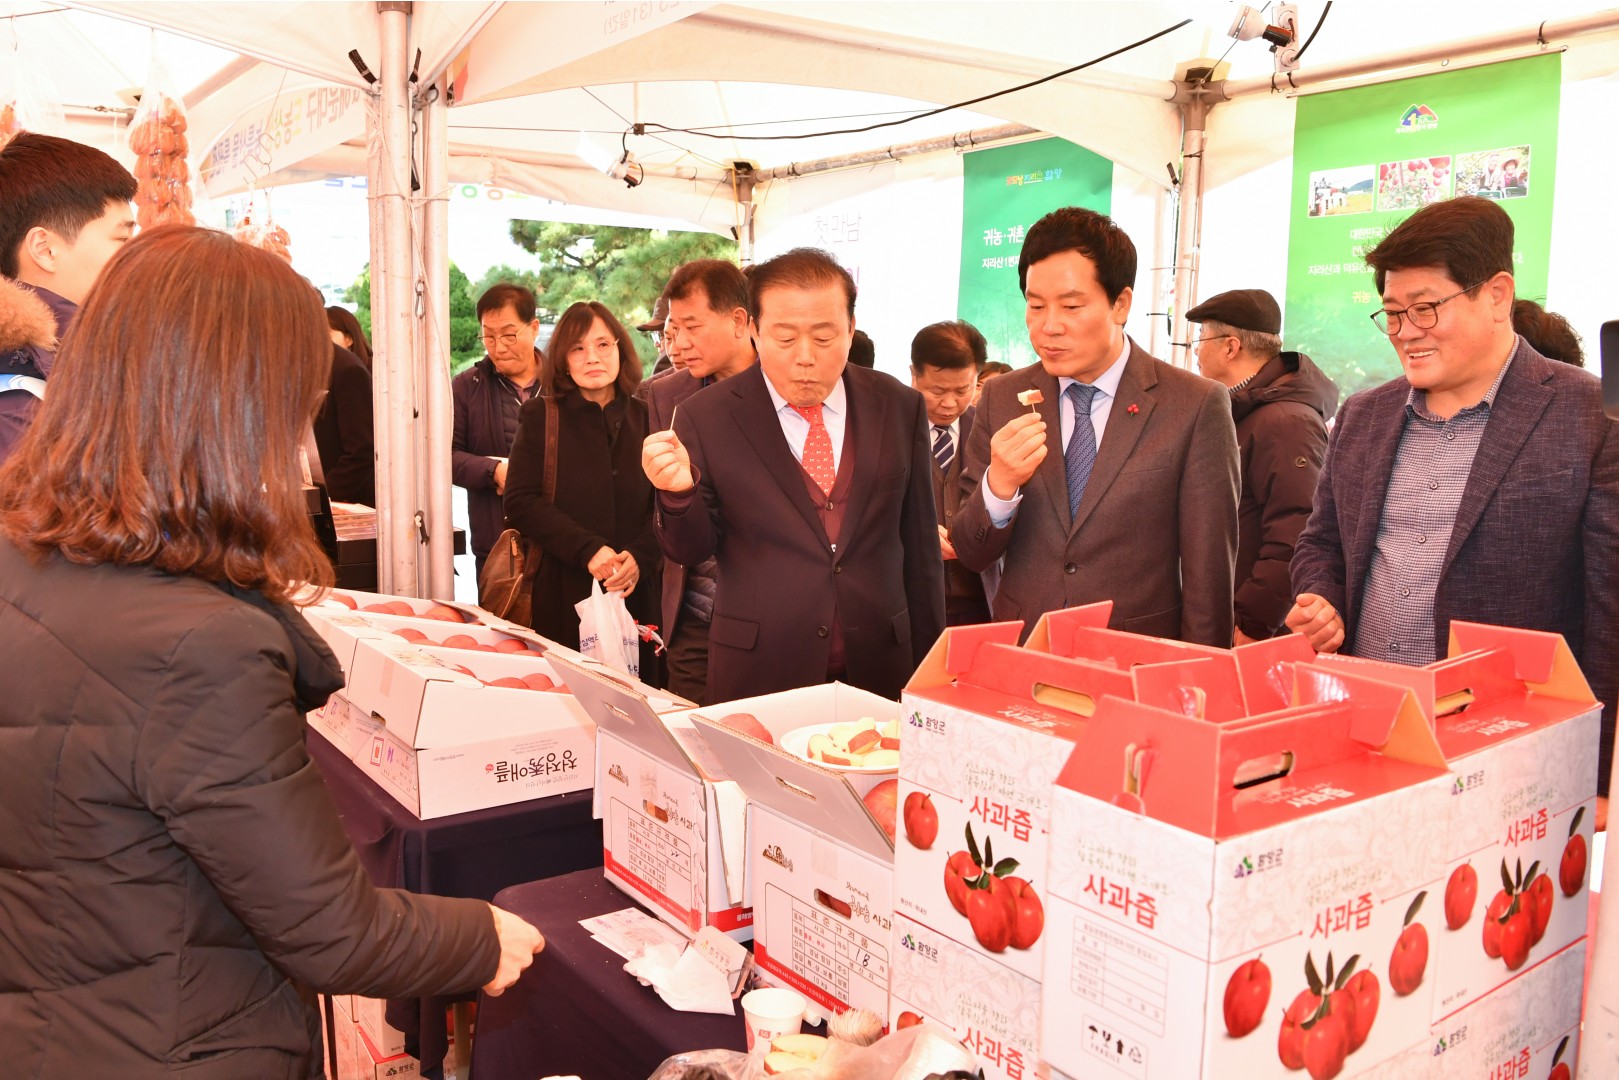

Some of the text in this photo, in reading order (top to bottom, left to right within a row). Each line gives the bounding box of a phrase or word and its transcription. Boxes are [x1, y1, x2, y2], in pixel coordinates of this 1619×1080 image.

[814, 211, 862, 246] 첫만남
[1350, 228, 1383, 240] 대한민국
[1308, 263, 1341, 276] 지리산과
[925, 716, 946, 732] 함양군
[494, 750, 578, 784] 청정秀애플
[969, 795, 1033, 843] 사과즙
[1504, 808, 1549, 848] 사과즙
[1083, 874, 1158, 930] 사과즙
[1310, 892, 1374, 939] 사과즙
[872, 913, 893, 932] 사과
[855, 947, 871, 968] 18
[962, 1027, 1026, 1080] 사과즙
[1489, 1046, 1532, 1080] 사과즙
